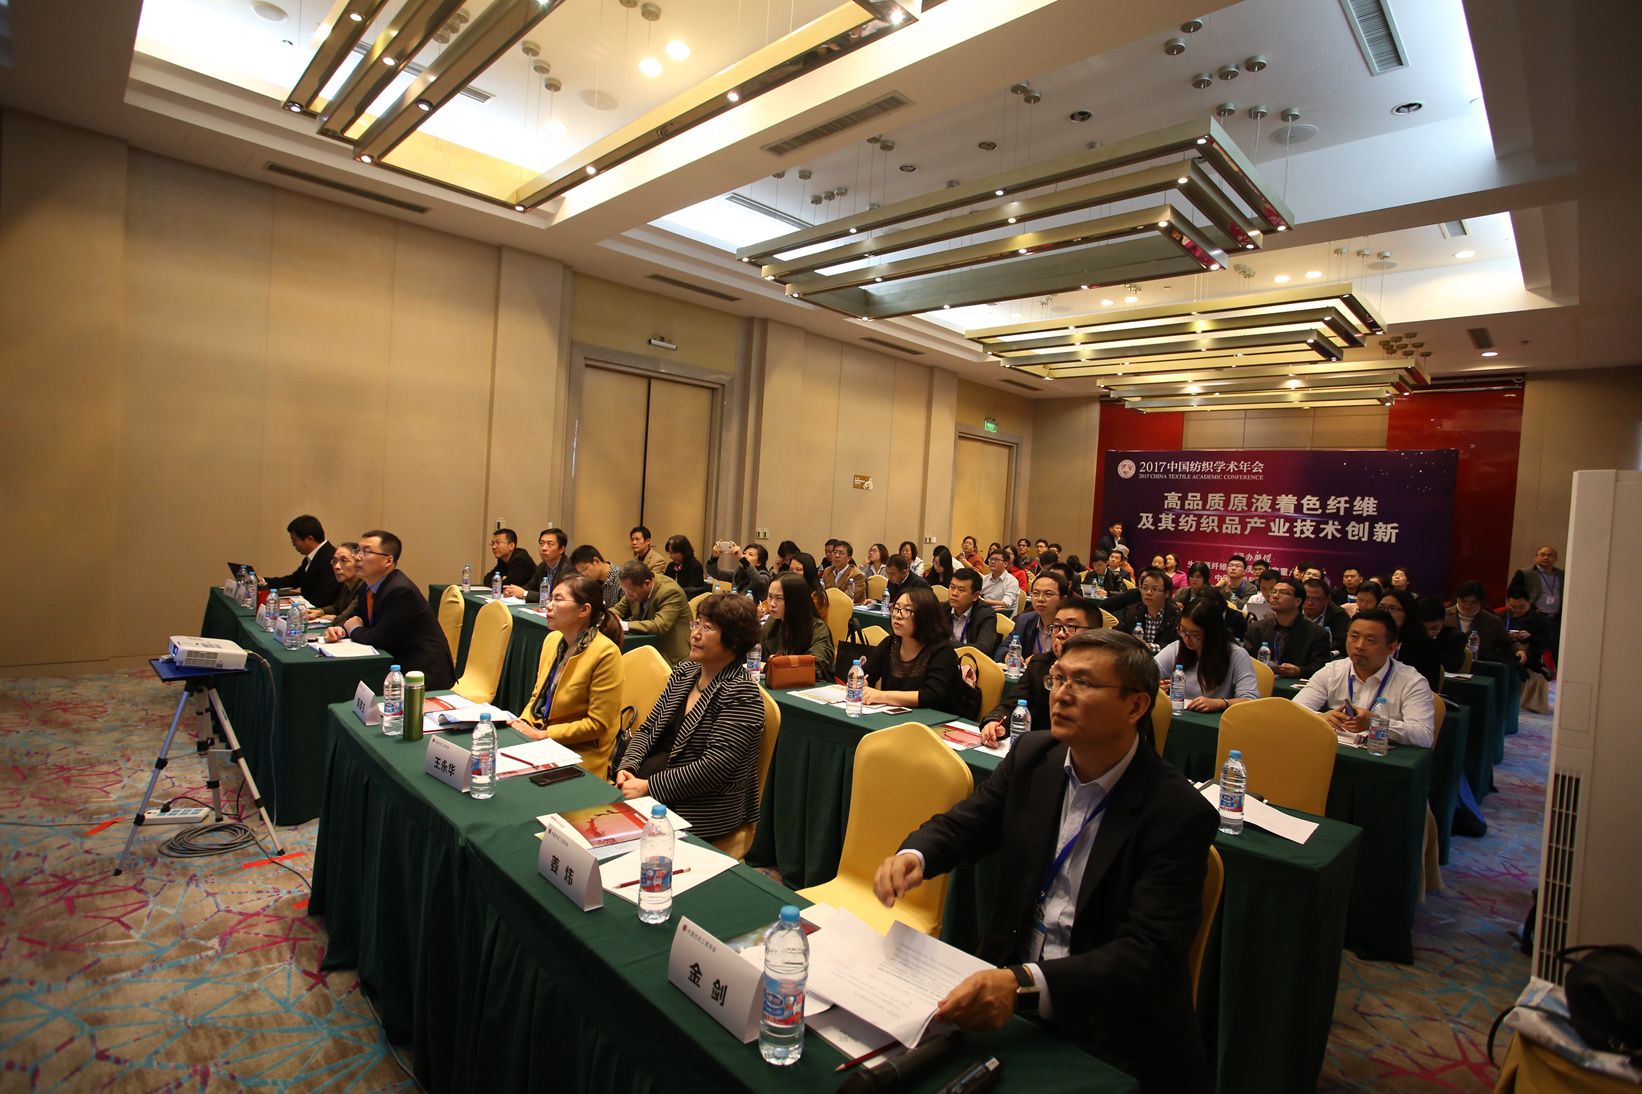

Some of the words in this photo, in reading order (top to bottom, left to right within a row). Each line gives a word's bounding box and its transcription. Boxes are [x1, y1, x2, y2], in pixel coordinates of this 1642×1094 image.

[1139, 461, 1264, 473] 2017中国纺织学术年会
[1164, 492, 1378, 517] 高品质原液着色纤维
[1137, 512, 1399, 543] 及其纺织品产业技术创新
[688, 962, 728, 1007] 金剑
